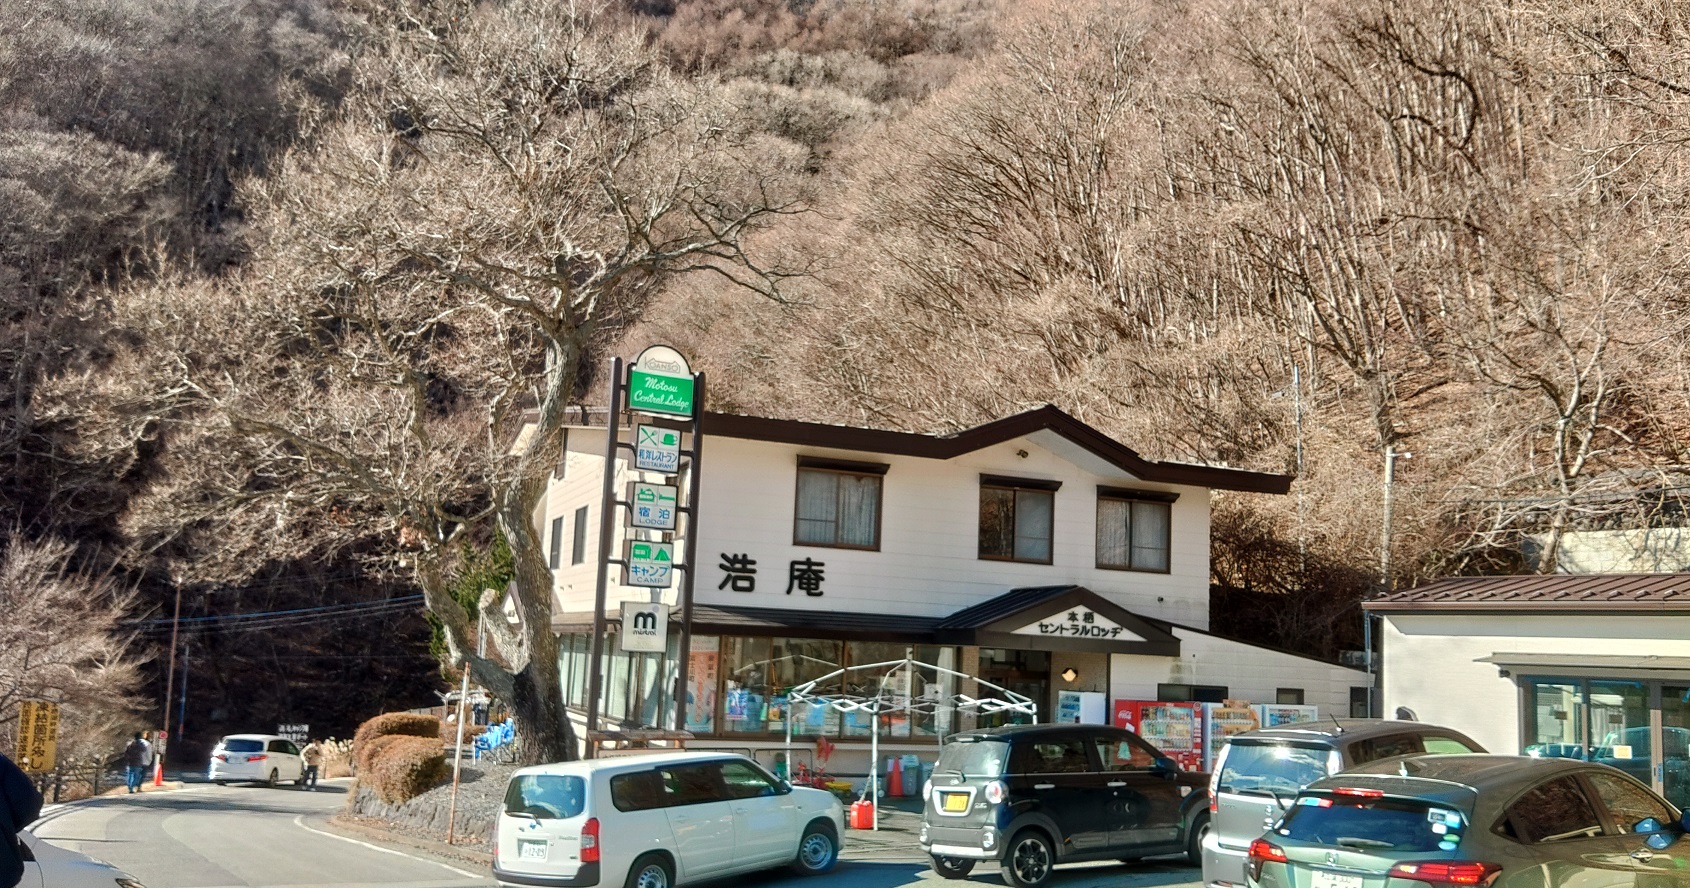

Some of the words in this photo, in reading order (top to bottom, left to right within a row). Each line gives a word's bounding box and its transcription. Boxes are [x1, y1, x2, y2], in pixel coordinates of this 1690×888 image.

[645, 377, 678, 393] Motosu
[633, 390, 665, 405] Central
[664, 394, 689, 411] Lodge
[639, 461, 675, 470] RESTAURANT
[638, 506, 671, 520] 宿泊
[631, 564, 670, 578] キャンプ
[718, 552, 825, 597] 浩庵
[636, 576, 664, 584] CAMP
[1067, 611, 1095, 624] 本栖
